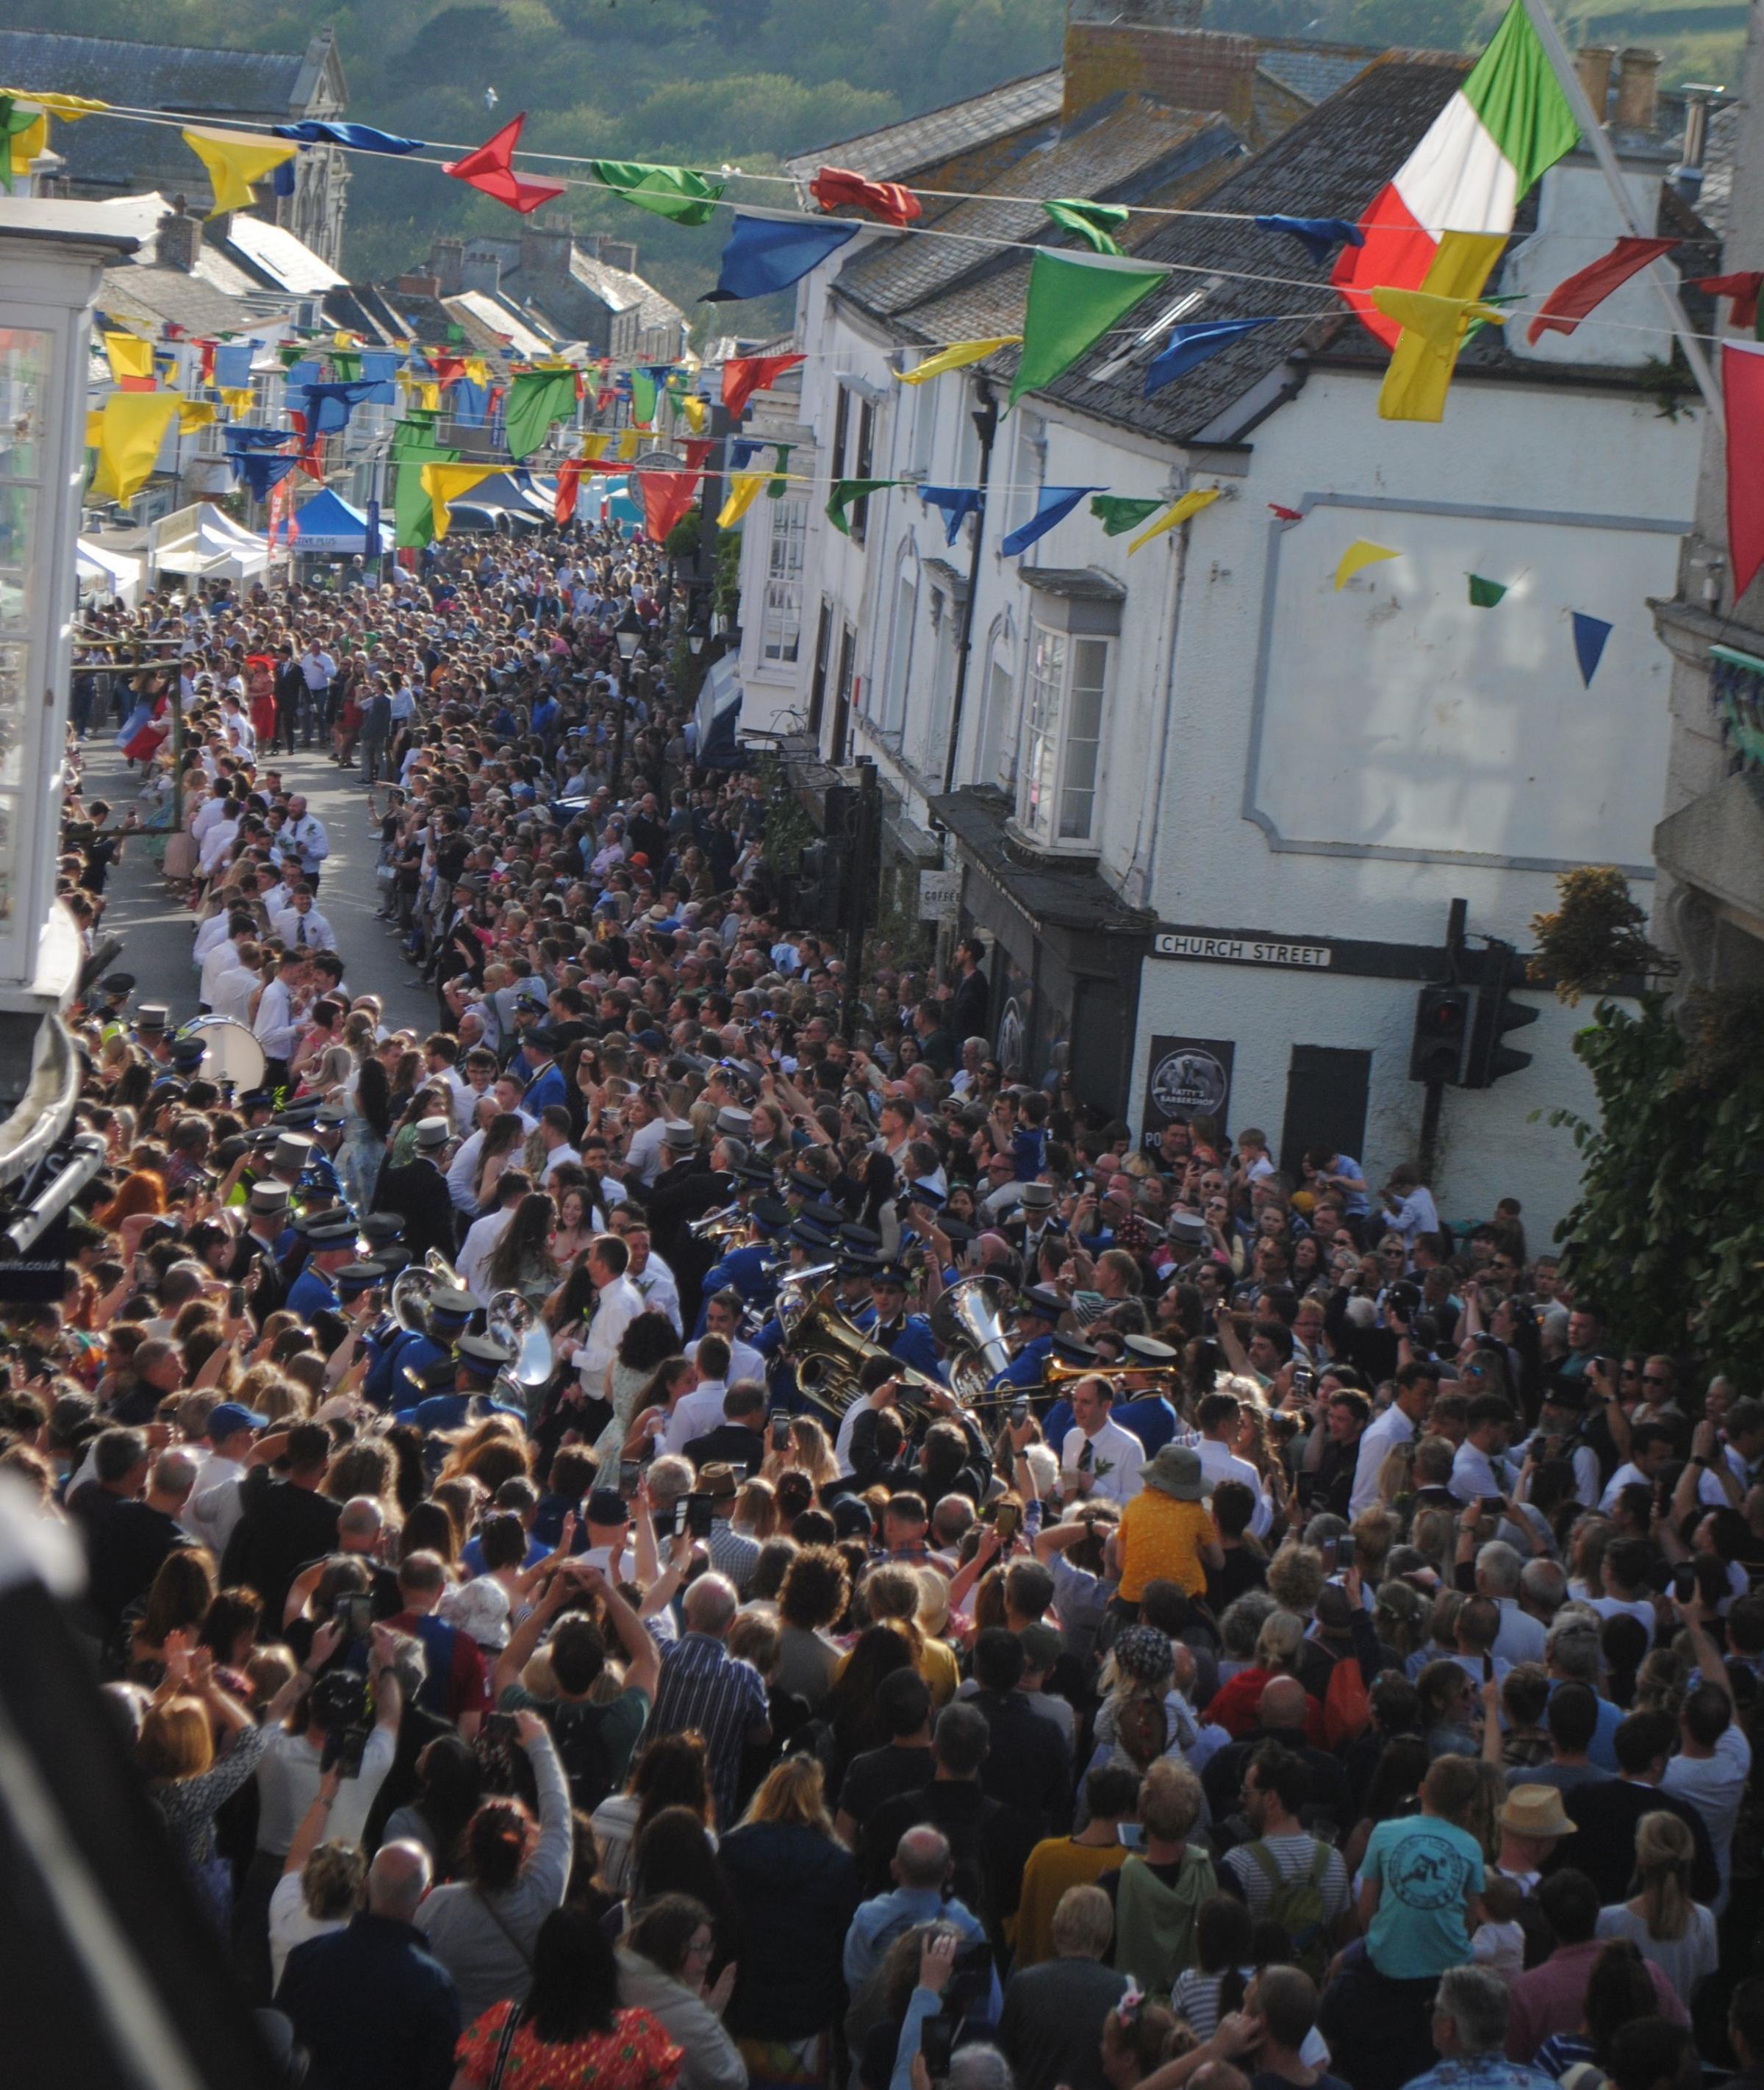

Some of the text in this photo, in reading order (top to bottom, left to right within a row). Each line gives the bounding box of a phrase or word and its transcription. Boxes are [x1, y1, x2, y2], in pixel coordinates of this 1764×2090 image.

[317, 537, 336, 545] PLUS
[925, 891, 961, 901] COFFEE
[1162, 937, 1324, 964] CHURCH STREET
[1172, 1088, 1205, 1097] FATTY'S
[1160, 1095, 1215, 1106] BARBERSHOP
